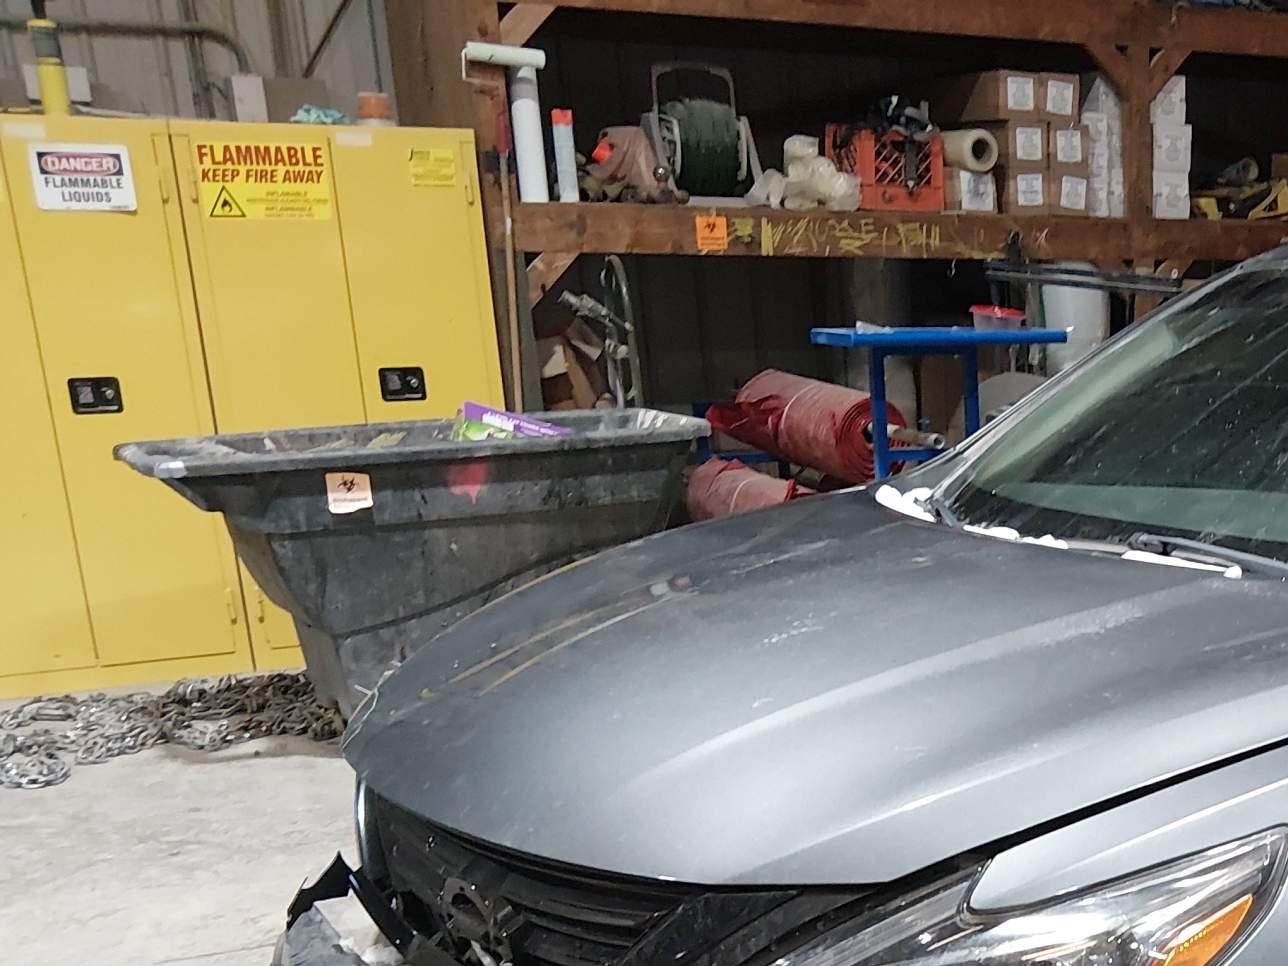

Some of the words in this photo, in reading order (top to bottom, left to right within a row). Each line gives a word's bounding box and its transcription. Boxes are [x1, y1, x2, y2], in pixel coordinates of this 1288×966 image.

[196, 144, 325, 167] FLAMMABLE
[46, 156, 115, 172] DANGER
[44, 176, 124, 189] FLAMMABLE
[201, 167, 241, 183] KEEP
[245, 168, 279, 184] FIRE
[282, 169, 324, 184] AWAY
[61, 190, 112, 203] LIQUIDS
